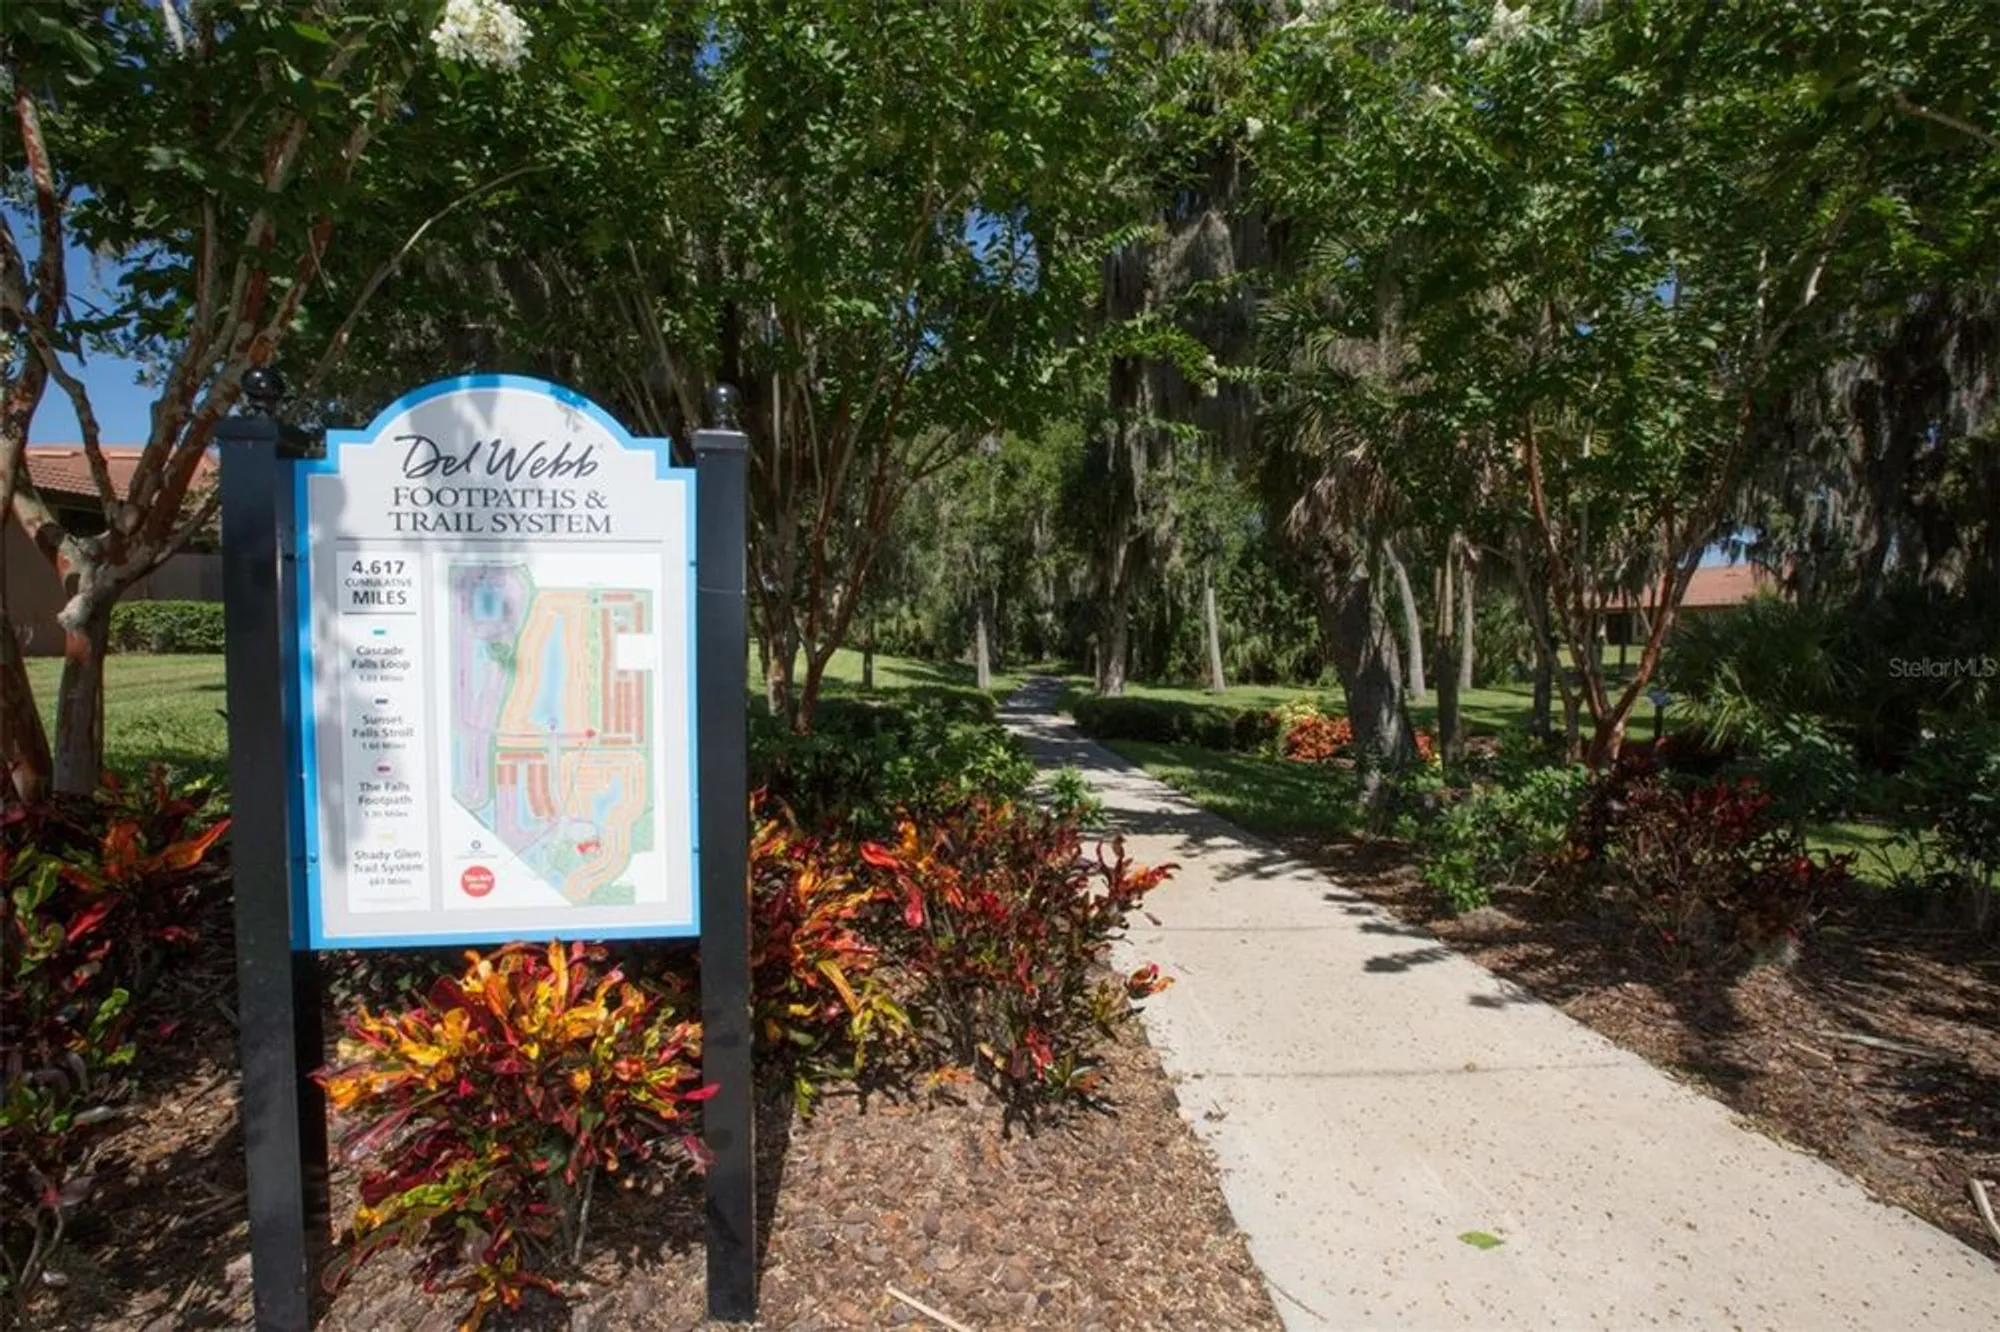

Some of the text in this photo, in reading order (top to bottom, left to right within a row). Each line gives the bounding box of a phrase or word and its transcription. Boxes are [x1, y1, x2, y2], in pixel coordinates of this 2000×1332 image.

[394, 434, 600, 482] Del Webb
[393, 486, 608, 509] FOOTPATHS &
[387, 511, 613, 534] TRAIL SYSTEM
[352, 560, 405, 575] 4.617
[344, 577, 412, 588] CUMULATIVE
[352, 590, 407, 605] MILES
[356, 645, 404, 656] Cascade
[351, 658, 411, 670] Falls Loop
[362, 714, 402, 725] Sunset
[352, 727, 414, 738] Falls Stroll
[358, 781, 411, 791] The Falls
[358, 794, 413, 806] Footpath
[354, 848, 421, 860] Shady Glen
[354, 863, 424, 874] Trail System
